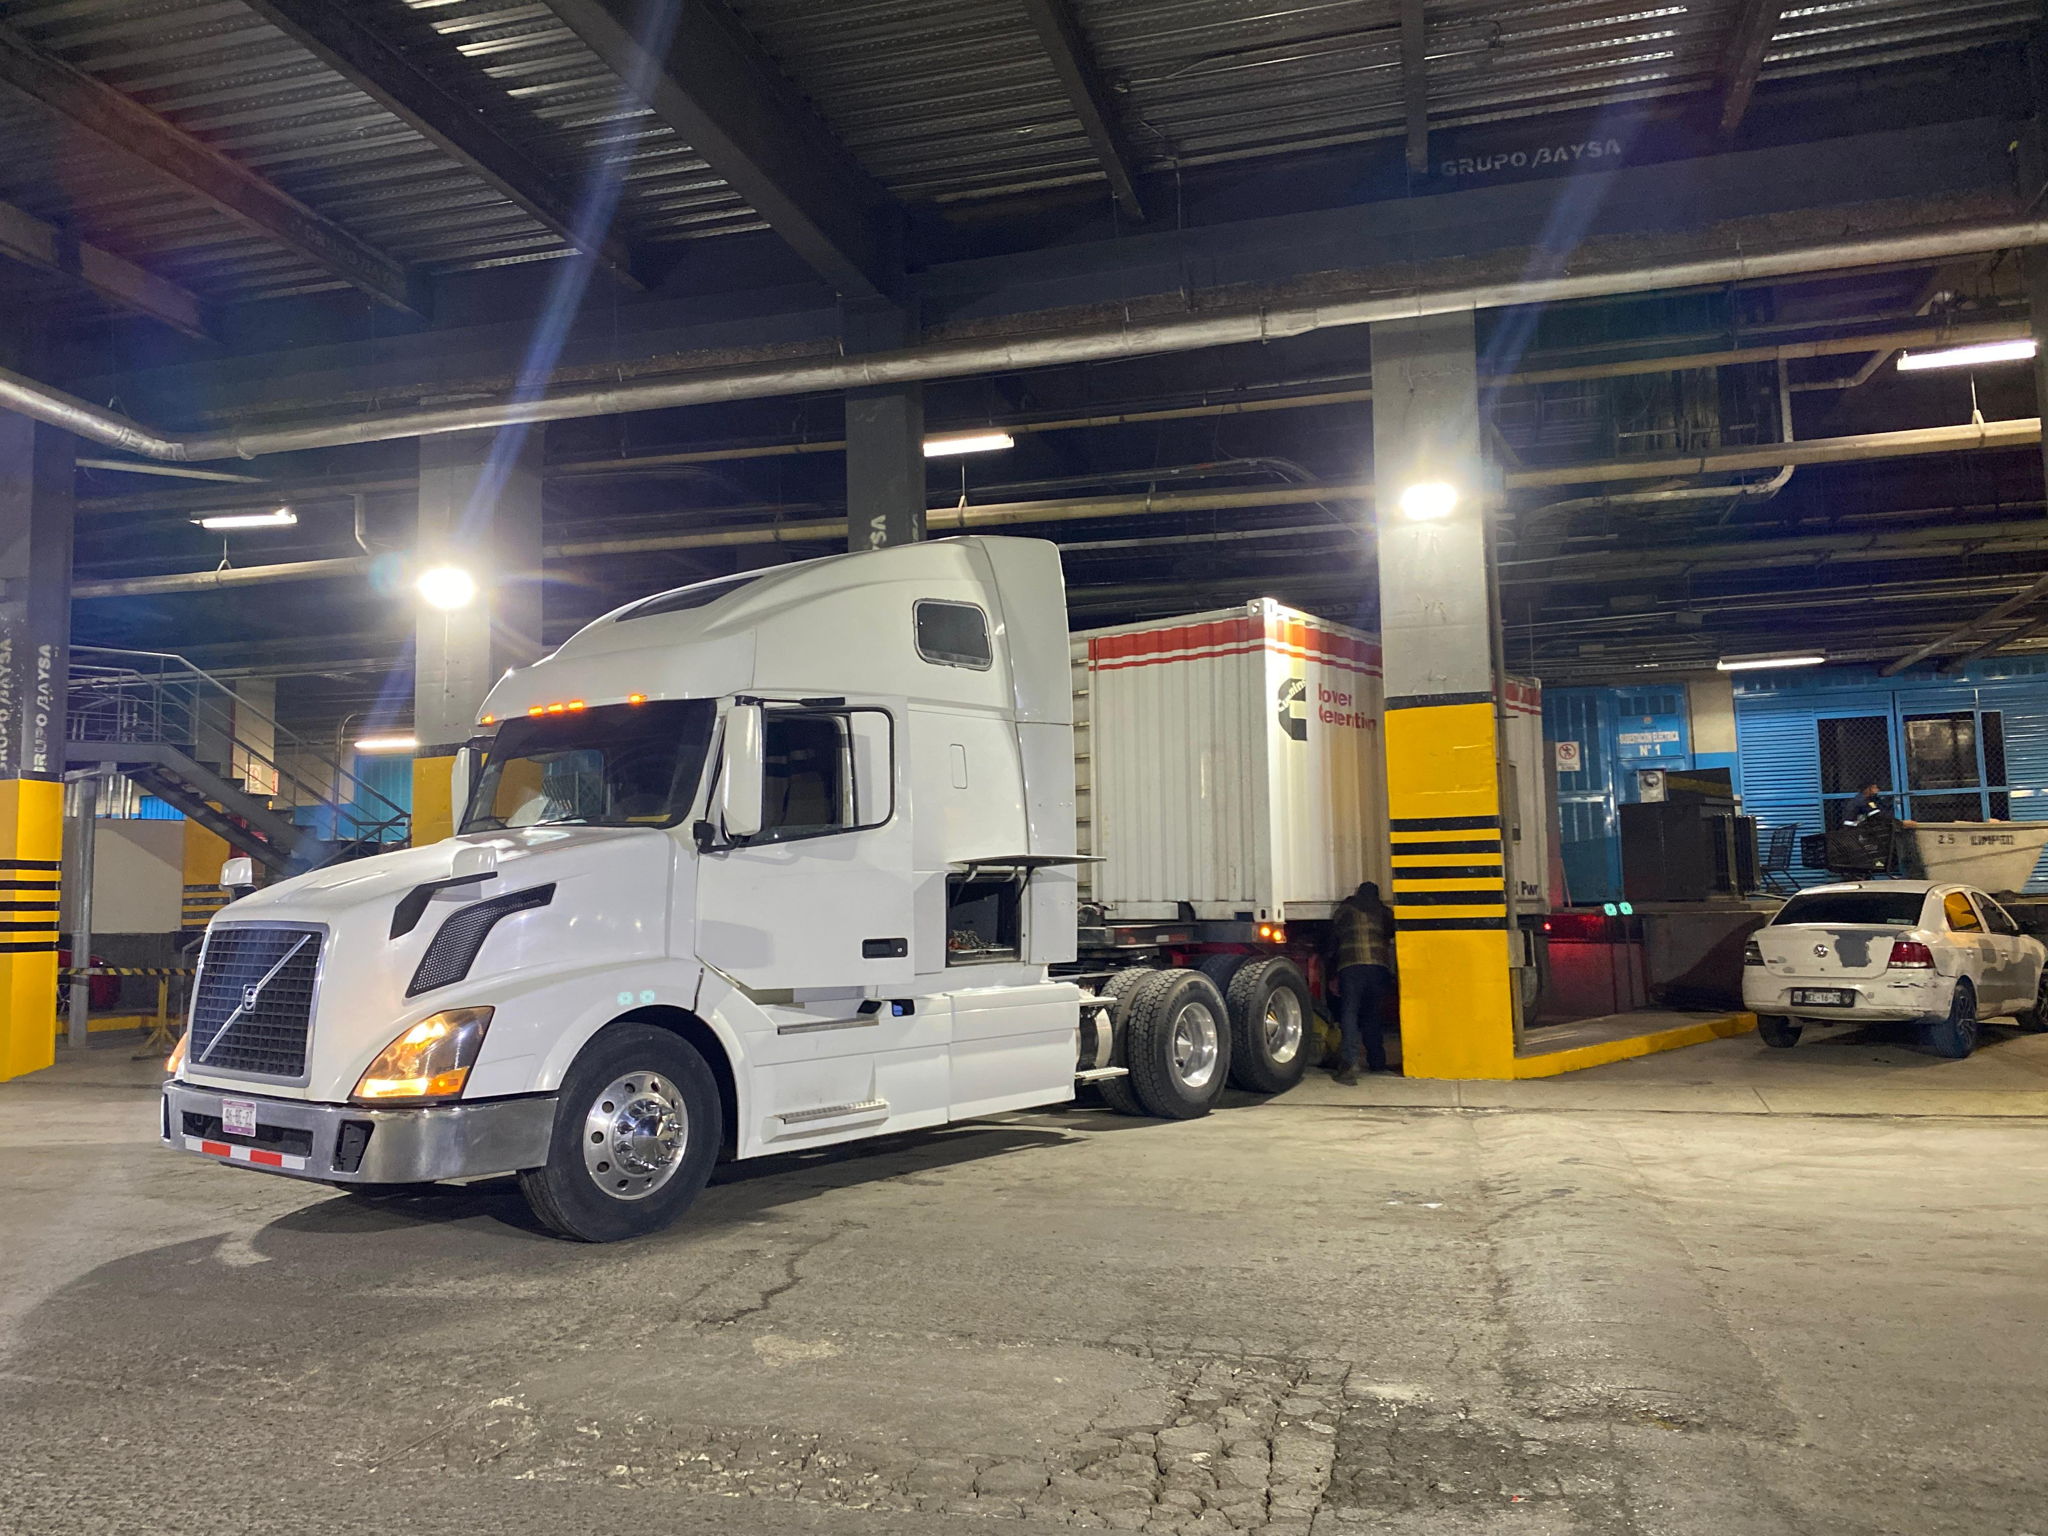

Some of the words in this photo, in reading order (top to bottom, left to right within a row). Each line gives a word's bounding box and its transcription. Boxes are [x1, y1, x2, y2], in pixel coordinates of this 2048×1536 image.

[1440, 151, 1526, 177] GRUPO
[1531, 138, 1622, 169] BAYSA
[36, 644, 52, 711] BAYSA
